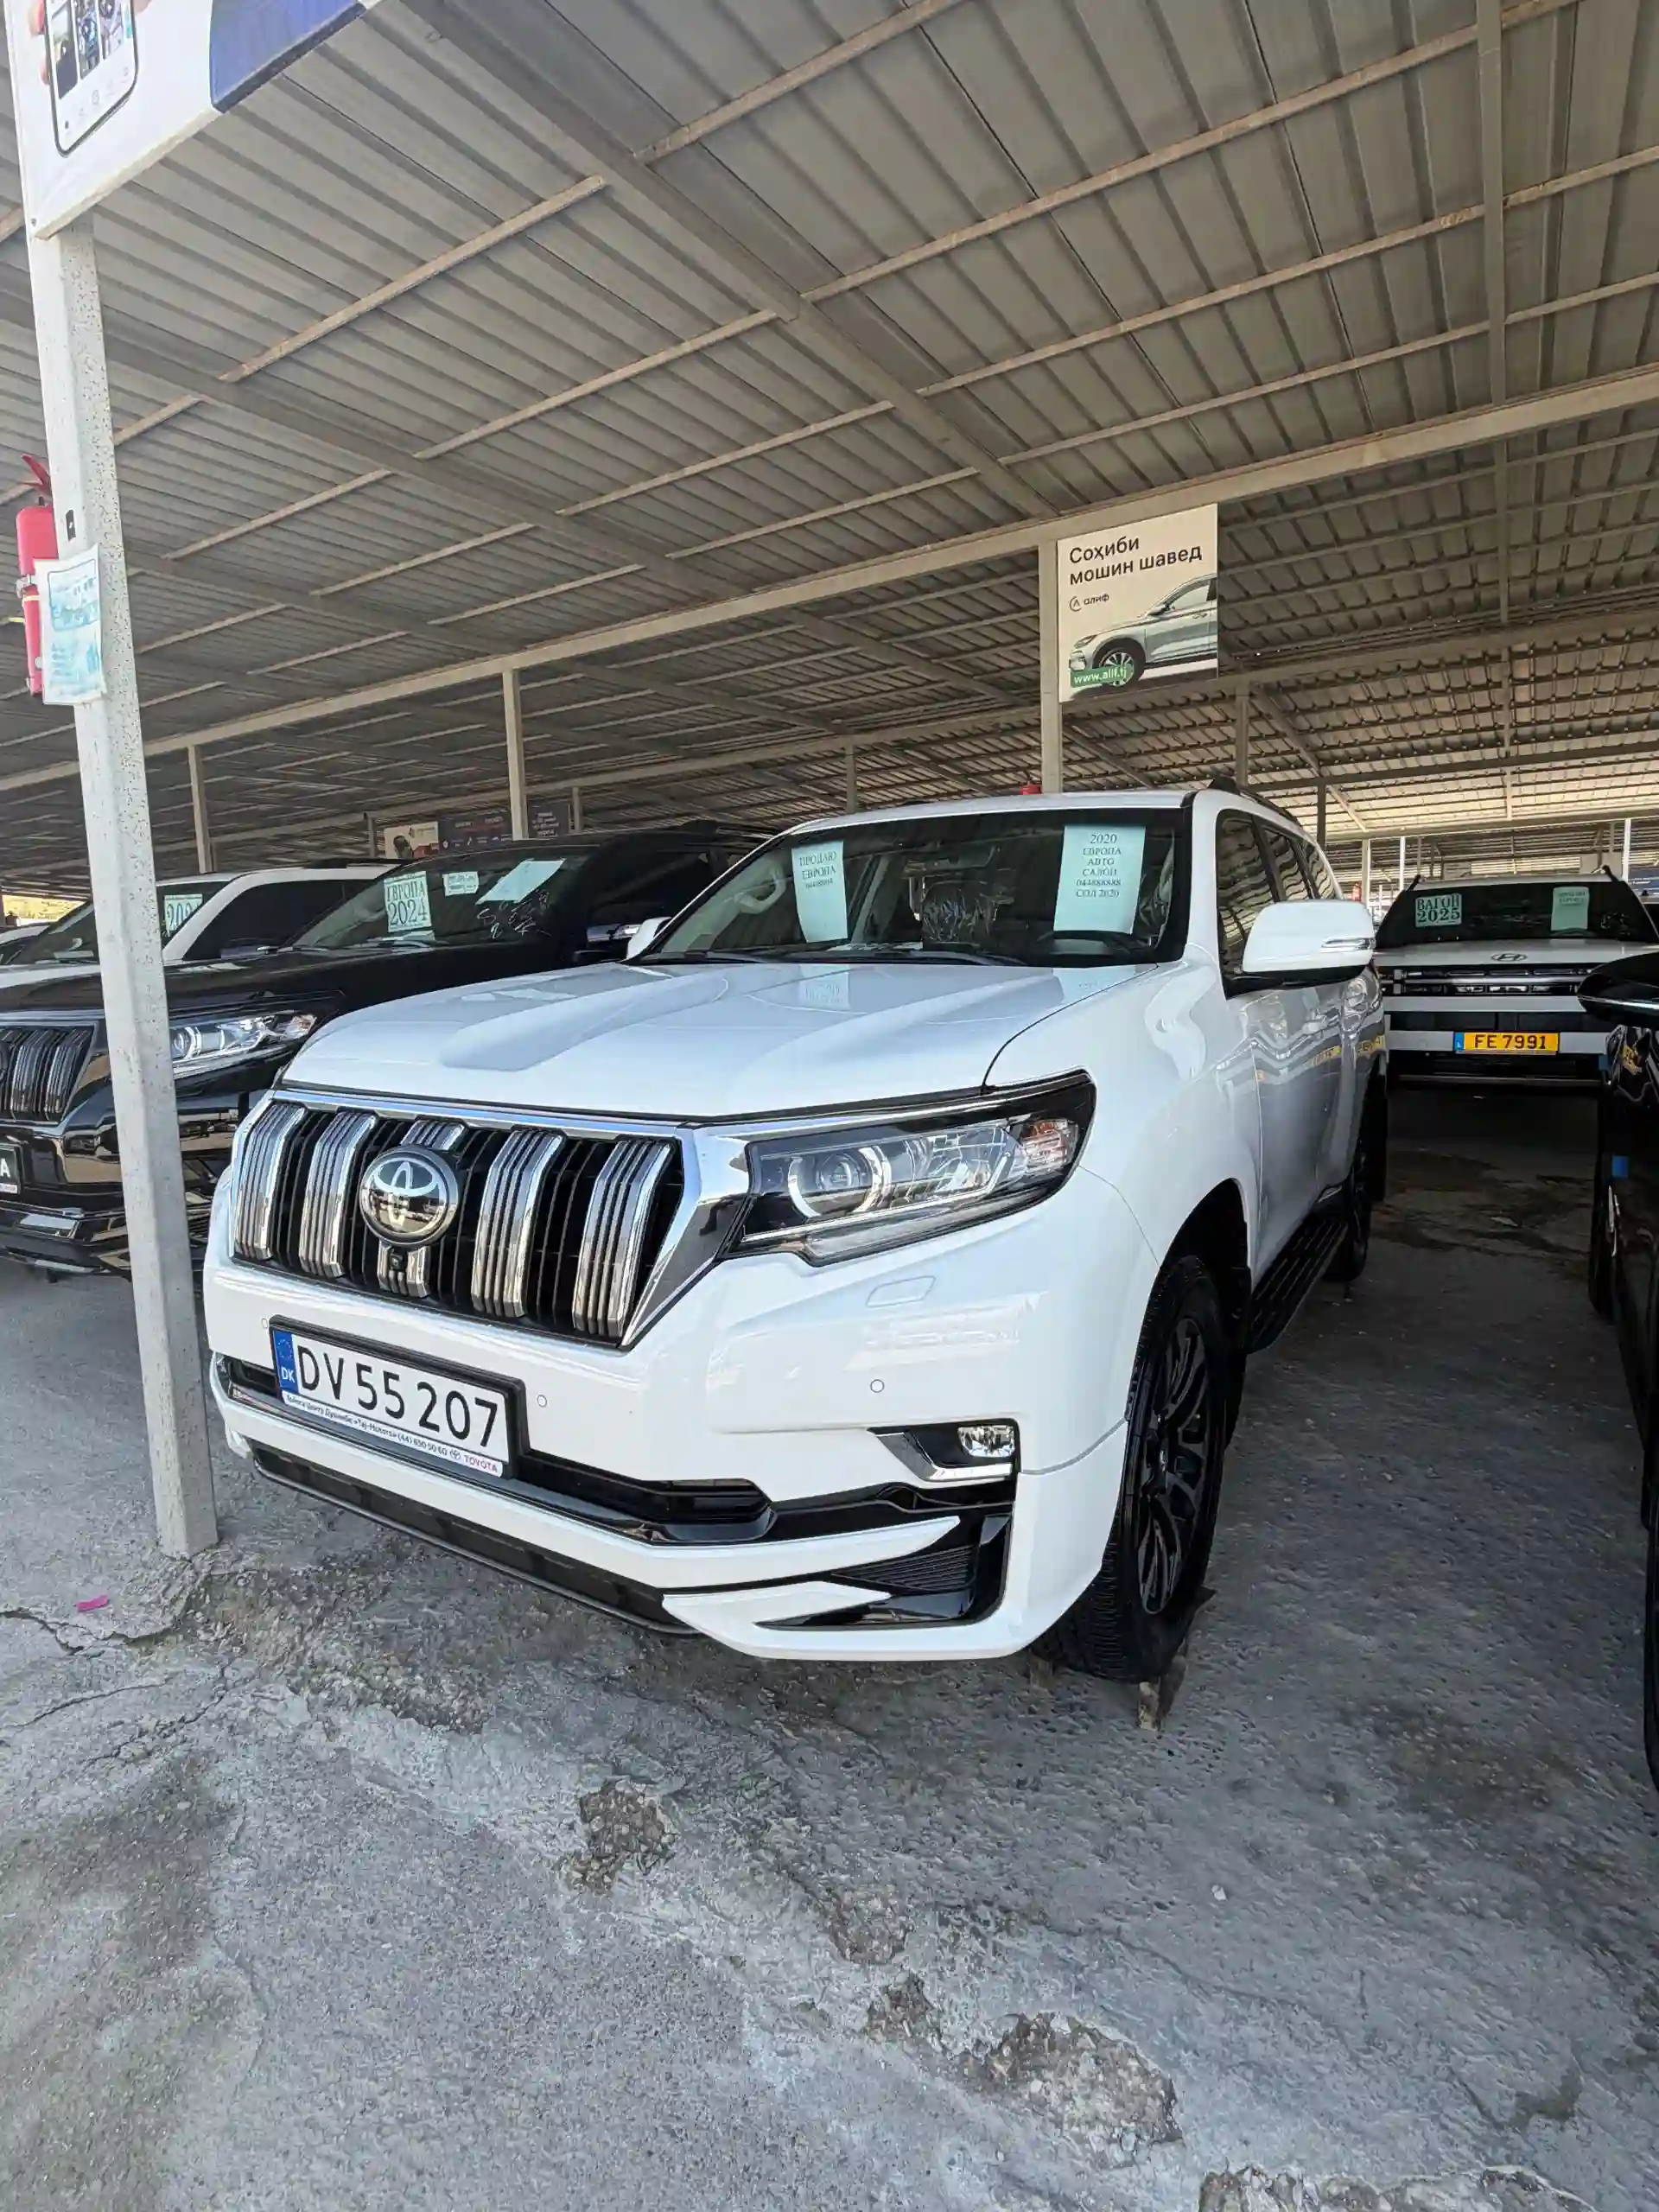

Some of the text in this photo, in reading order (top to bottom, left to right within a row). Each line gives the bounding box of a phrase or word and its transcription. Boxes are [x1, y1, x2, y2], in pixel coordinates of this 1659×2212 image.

[1069, 536, 1140, 563] Соҳиби
[1070, 545, 1203, 585] мошин шавед
[1084, 593, 1109, 606] алиф
[1090, 834, 1117, 844] 2020
[387, 899, 428, 925] 2024
[1417, 907, 1460, 923] 2025
[1474, 1034, 1546, 1050] FE 7991
[281, 1365, 296, 1383] DK
[297, 1344, 499, 1447] DV 55 207
[464, 1455, 499, 1473] TOYOTA
